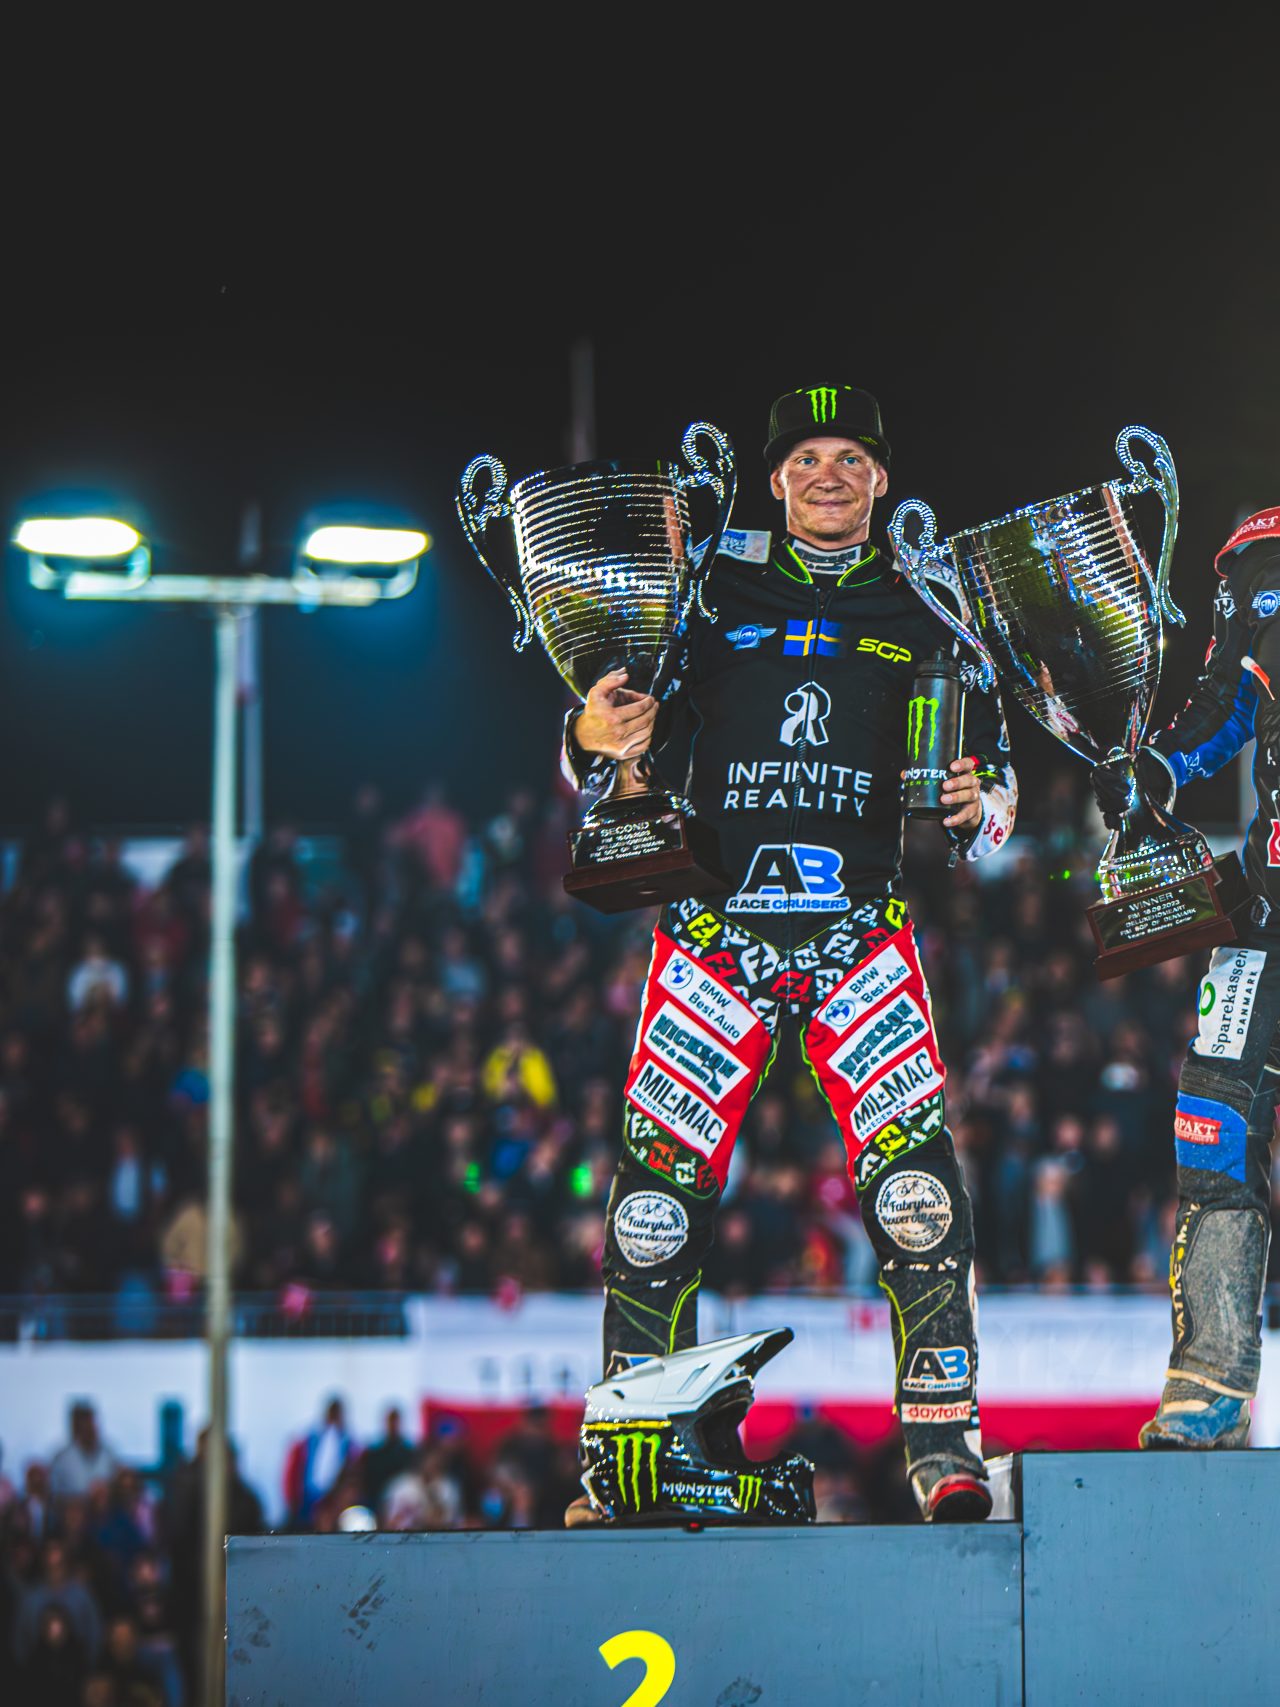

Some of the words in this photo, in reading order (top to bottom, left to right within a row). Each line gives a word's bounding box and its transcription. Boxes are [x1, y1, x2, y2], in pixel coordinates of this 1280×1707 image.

[856, 638, 912, 663] SGP
[728, 761, 873, 794] INFINITE
[723, 787, 865, 817] REALITY
[600, 821, 650, 838] SECOND
[737, 843, 845, 896] AB
[728, 899, 770, 910] RACE
[772, 898, 849, 910] CRUISERS
[1128, 892, 1174, 911] WINNER
[698, 979, 732, 1008] BMW
[849, 966, 879, 995] BMW
[861, 981, 888, 1004] Best
[688, 991, 715, 1017] Best
[714, 1015, 740, 1040] Auto
[1211, 950, 1249, 1055] Sparekassen
[1237, 971, 1258, 1035] DANMARK
[908, 1346, 970, 1380] AB
[661, 1482, 735, 1498] MONSTER
[599, 1630, 676, 1707] 2
